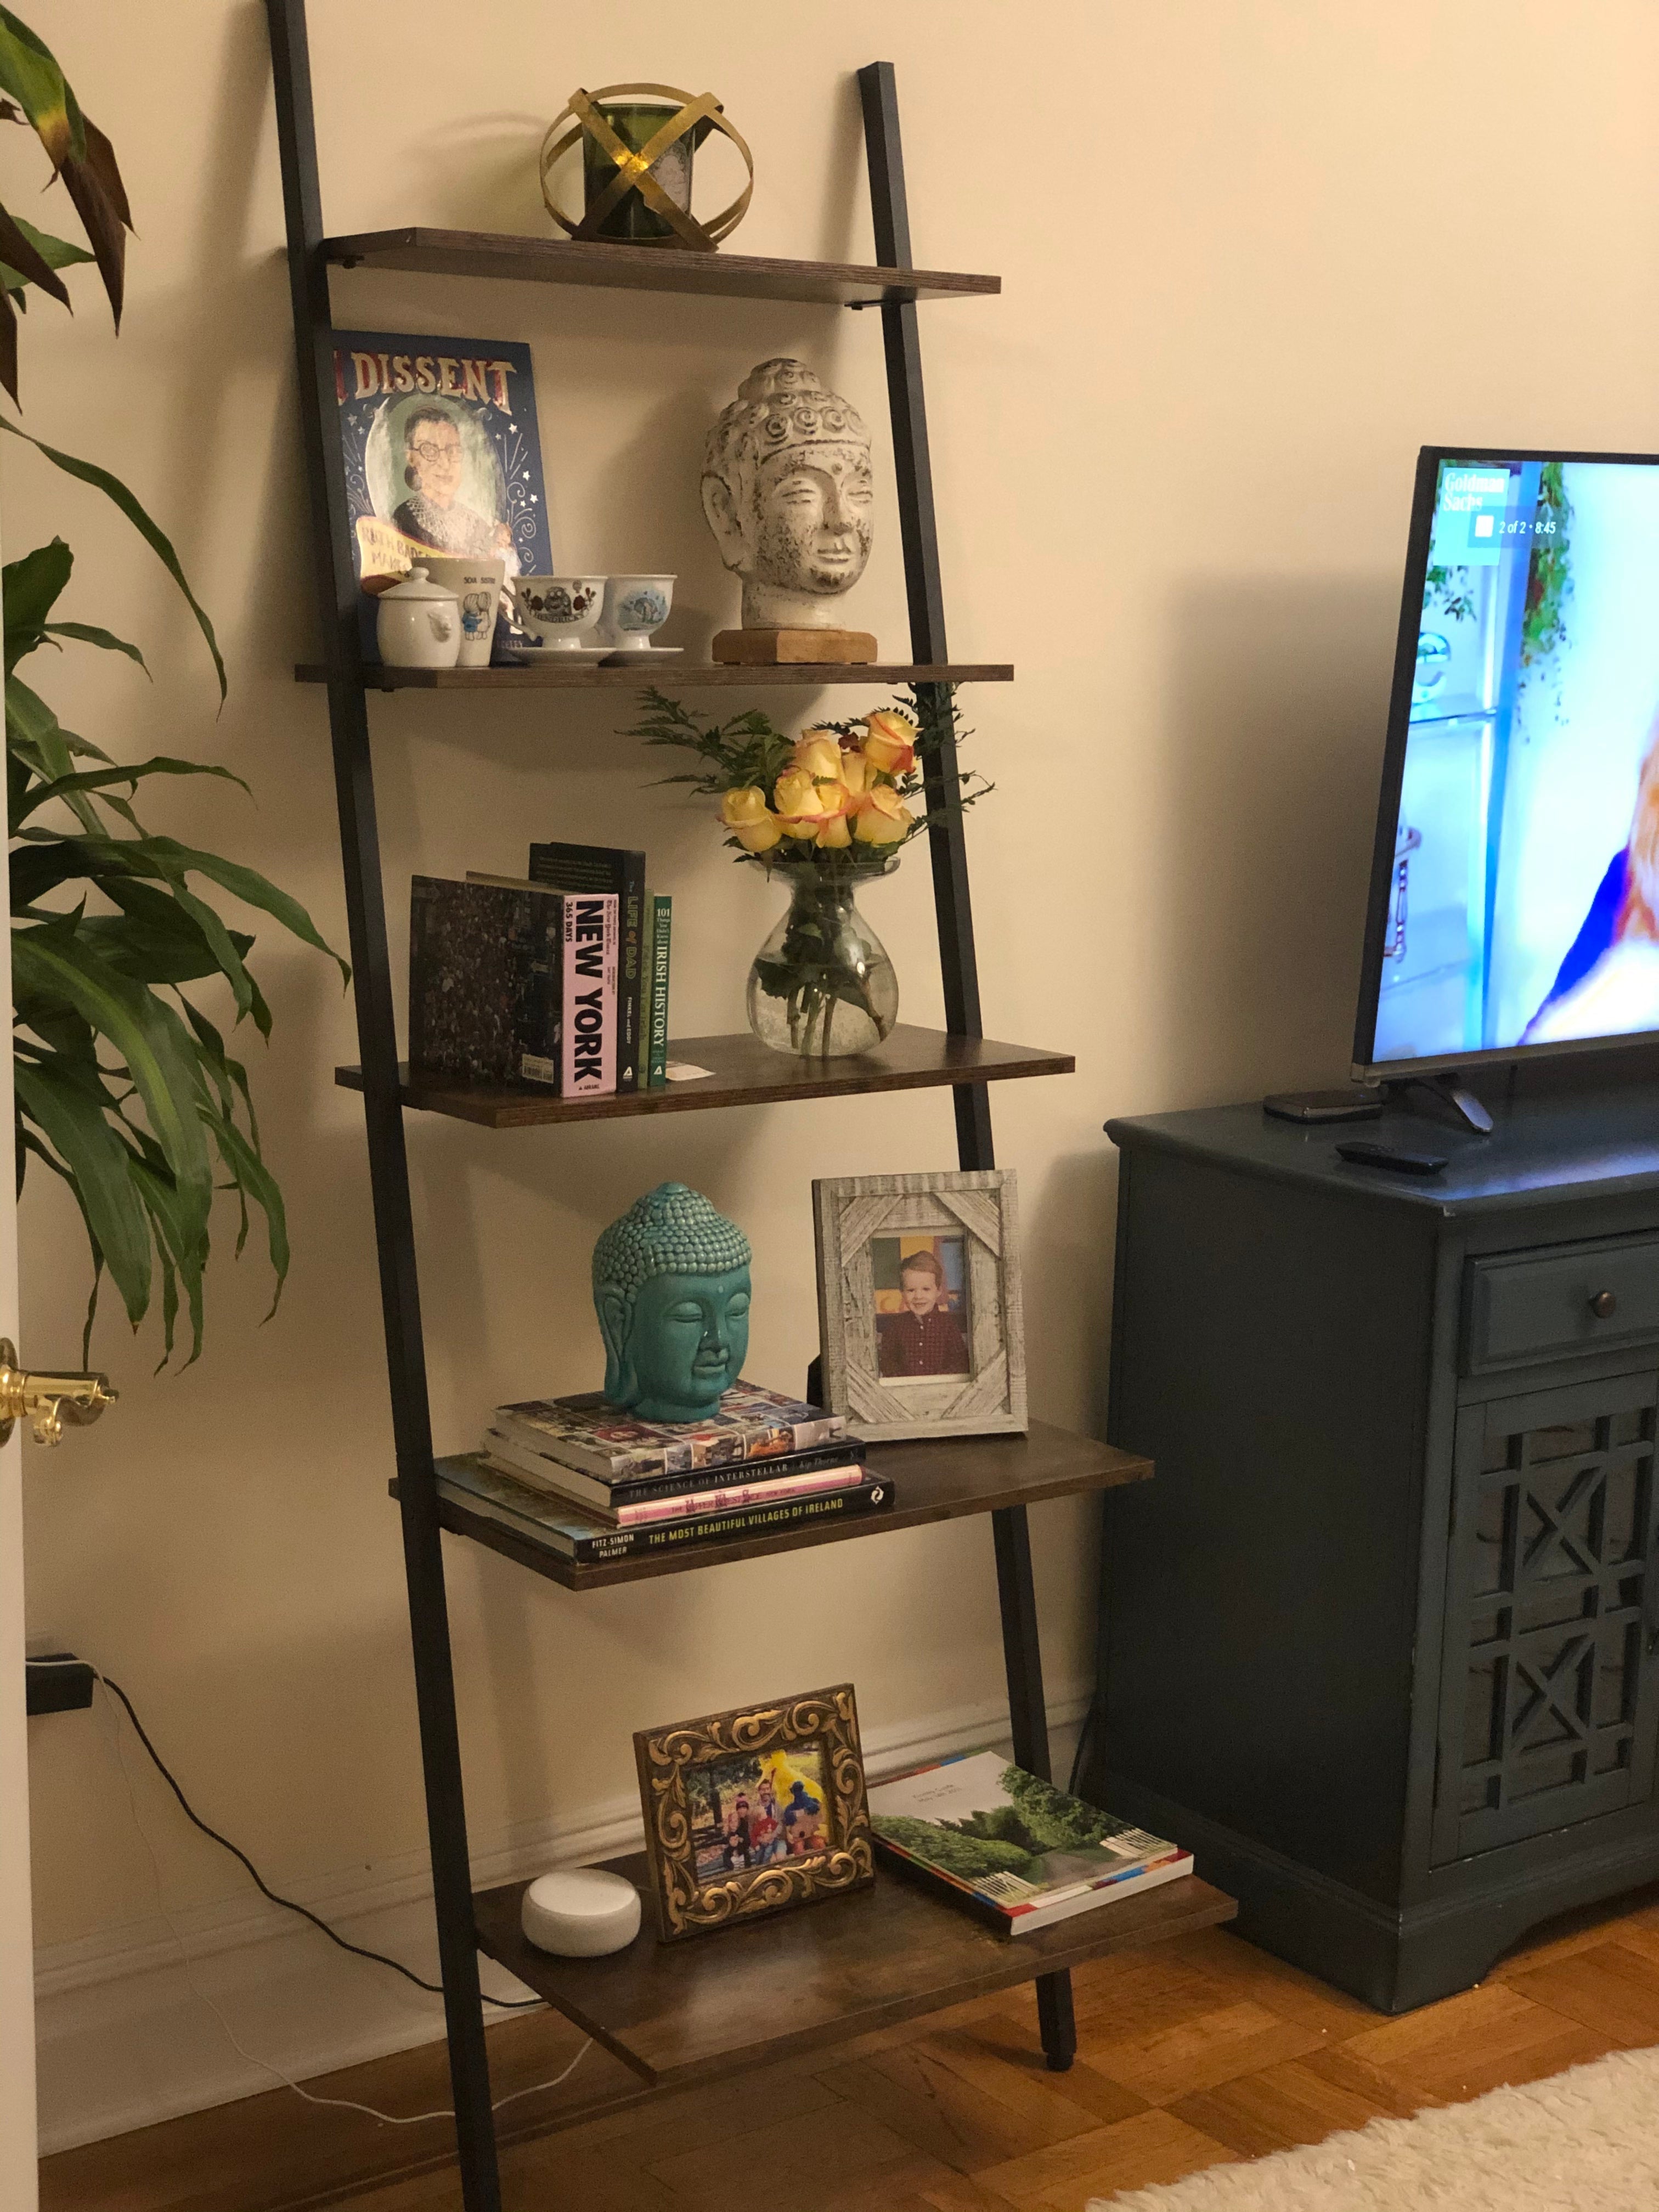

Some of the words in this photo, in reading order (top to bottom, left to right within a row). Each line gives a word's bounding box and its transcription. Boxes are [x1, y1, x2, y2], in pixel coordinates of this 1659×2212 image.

[351, 352, 517, 416] DISSENT
[1444, 472, 1505, 493] Goldman
[1443, 492, 1483, 511] Sachs
[1499, 521, 1506, 534] 2
[1507, 520, 1519, 534] of
[1519, 521, 1526, 534] 2
[1534, 521, 1556, 534] 8:45
[627, 896, 638, 927] LIFE
[657, 908, 670, 917] 101
[575, 900, 604, 978] NEW
[625, 930, 637, 944] of
[625, 947, 637, 979] DAD
[656, 946, 667, 983] IRISH
[653, 987, 666, 1048] HISTORY
[574, 986, 603, 1083] YORK
[629, 1488, 647, 1498] THE
[652, 1480, 694, 1492] SCIENCE
[714, 1463, 788, 1484] INTERSTELLAR
[649, 1532, 665, 1544] THE
[669, 1526, 695, 1541] MOST
[697, 1517, 746, 1536] BEAUTIFUL
[748, 1508, 790, 1525] VILLAGES
[792, 1506, 803, 1517] OF
[805, 1498, 843, 1514] IRELAND
[592, 1533, 634, 1549] FITZ-SIMON
[599, 1546, 627, 1559] PALMER
